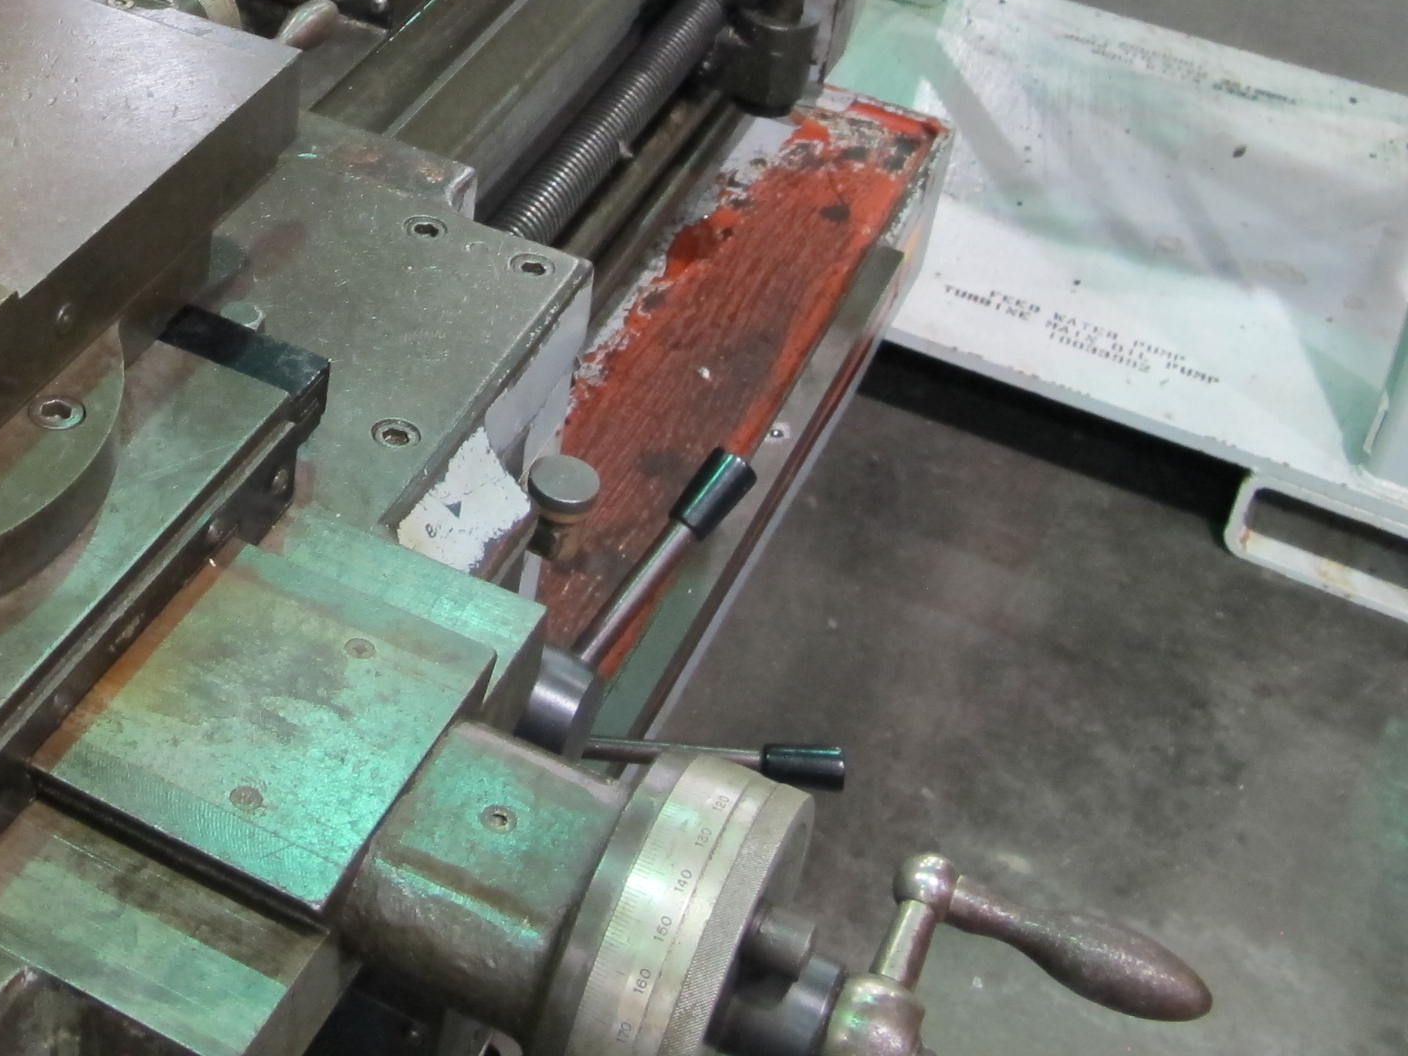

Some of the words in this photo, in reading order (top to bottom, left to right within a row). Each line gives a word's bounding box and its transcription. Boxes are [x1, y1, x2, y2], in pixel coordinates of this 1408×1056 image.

[712, 793, 730, 814] 120
[694, 826, 714, 849] 130
[674, 868, 693, 894] 140
[653, 914, 674, 943] 150
[632, 967, 653, 996] 160
[616, 1021, 634, 1046] 170
